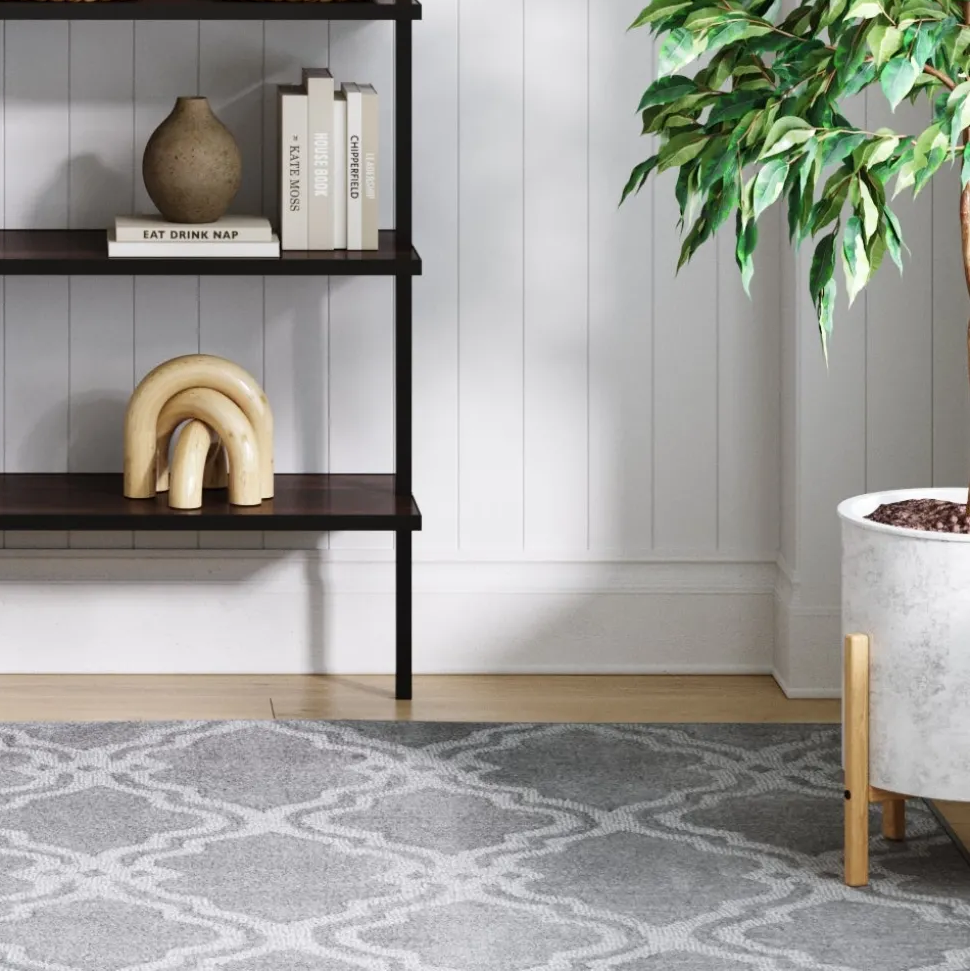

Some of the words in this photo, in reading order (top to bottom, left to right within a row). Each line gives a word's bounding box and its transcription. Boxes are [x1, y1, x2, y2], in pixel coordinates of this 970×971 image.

[289, 145, 300, 177] KATE
[313, 132, 329, 167] HOUSE
[313, 168, 329, 197] BOOK
[350, 134, 360, 199] CHIPPERFIELD
[289, 178, 300, 212] MOSS
[143, 230, 166, 239] EAT
[170, 230, 210, 239] DRINK
[213, 230, 239, 239] NAP
